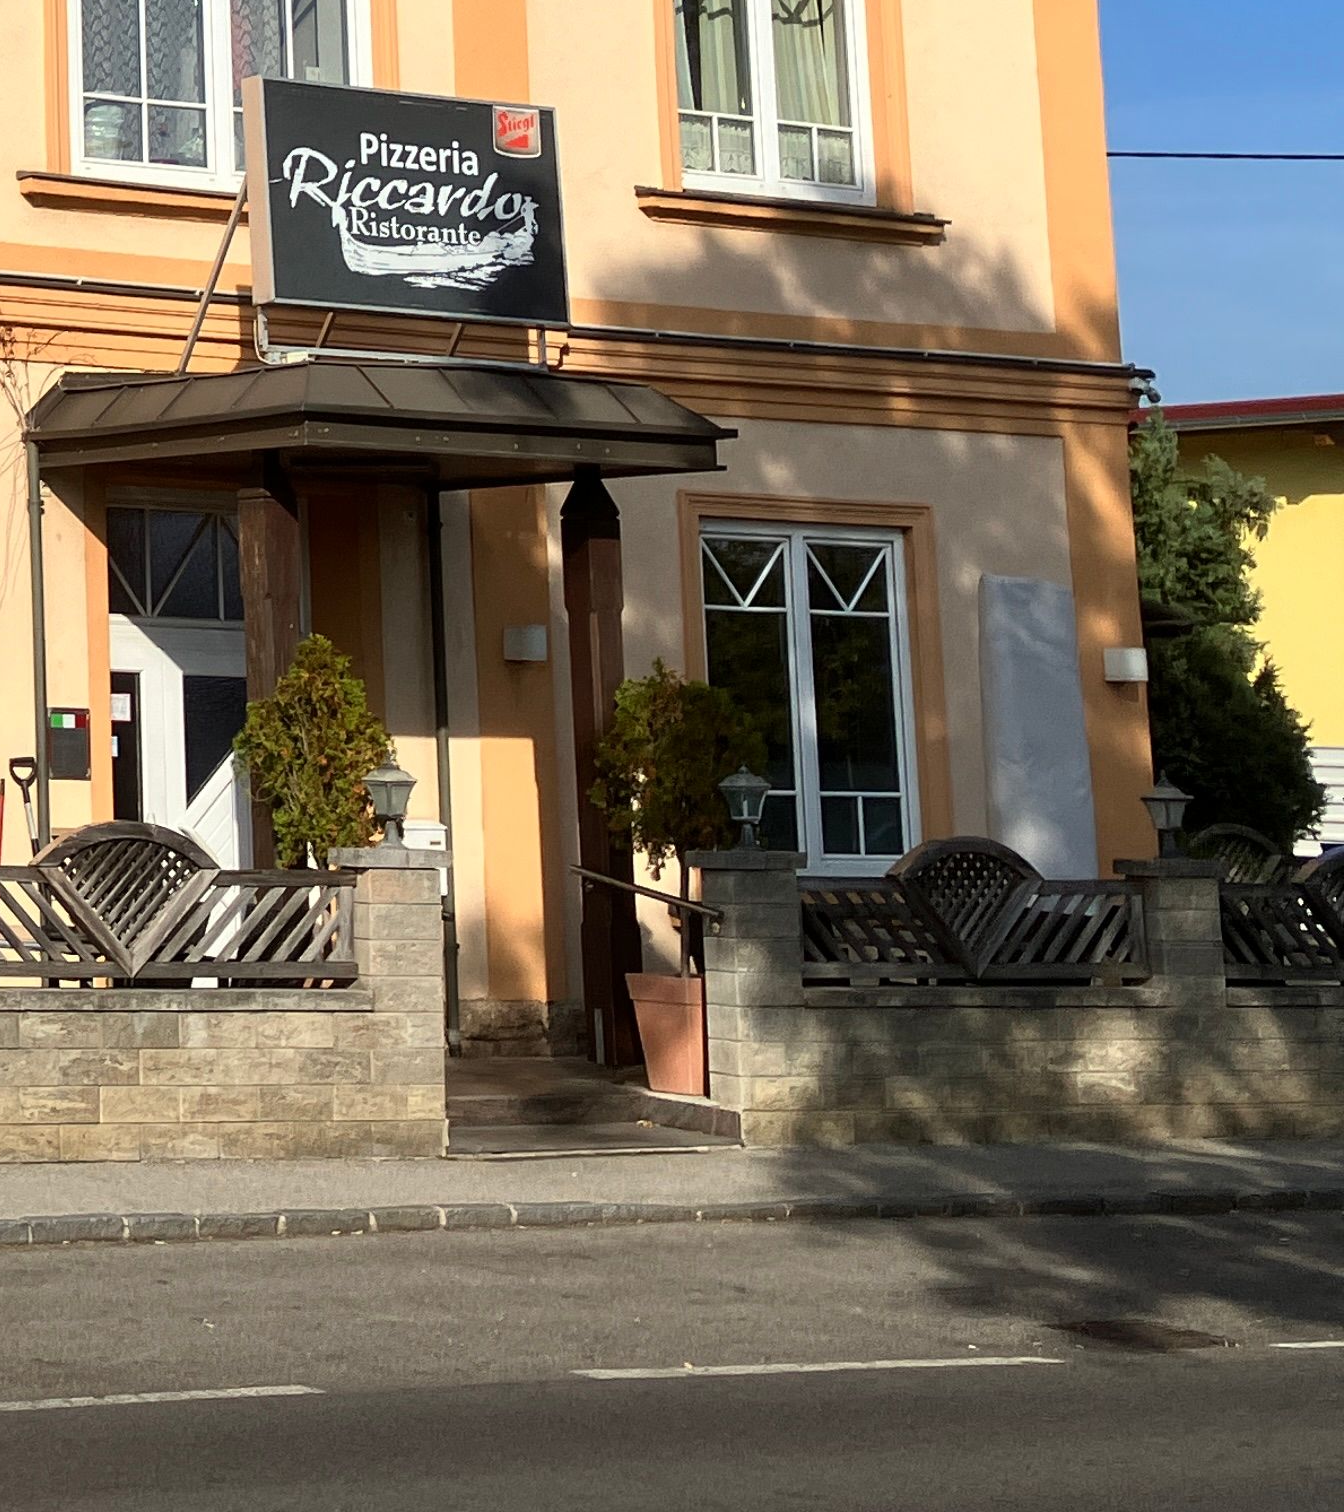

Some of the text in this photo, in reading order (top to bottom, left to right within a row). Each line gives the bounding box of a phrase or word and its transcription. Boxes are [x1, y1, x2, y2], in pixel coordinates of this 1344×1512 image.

[496, 110, 535, 137] Stiegl
[360, 133, 479, 176] Pizzeria
[282, 146, 523, 221] Riccardo
[349, 206, 483, 246] Ristorante
